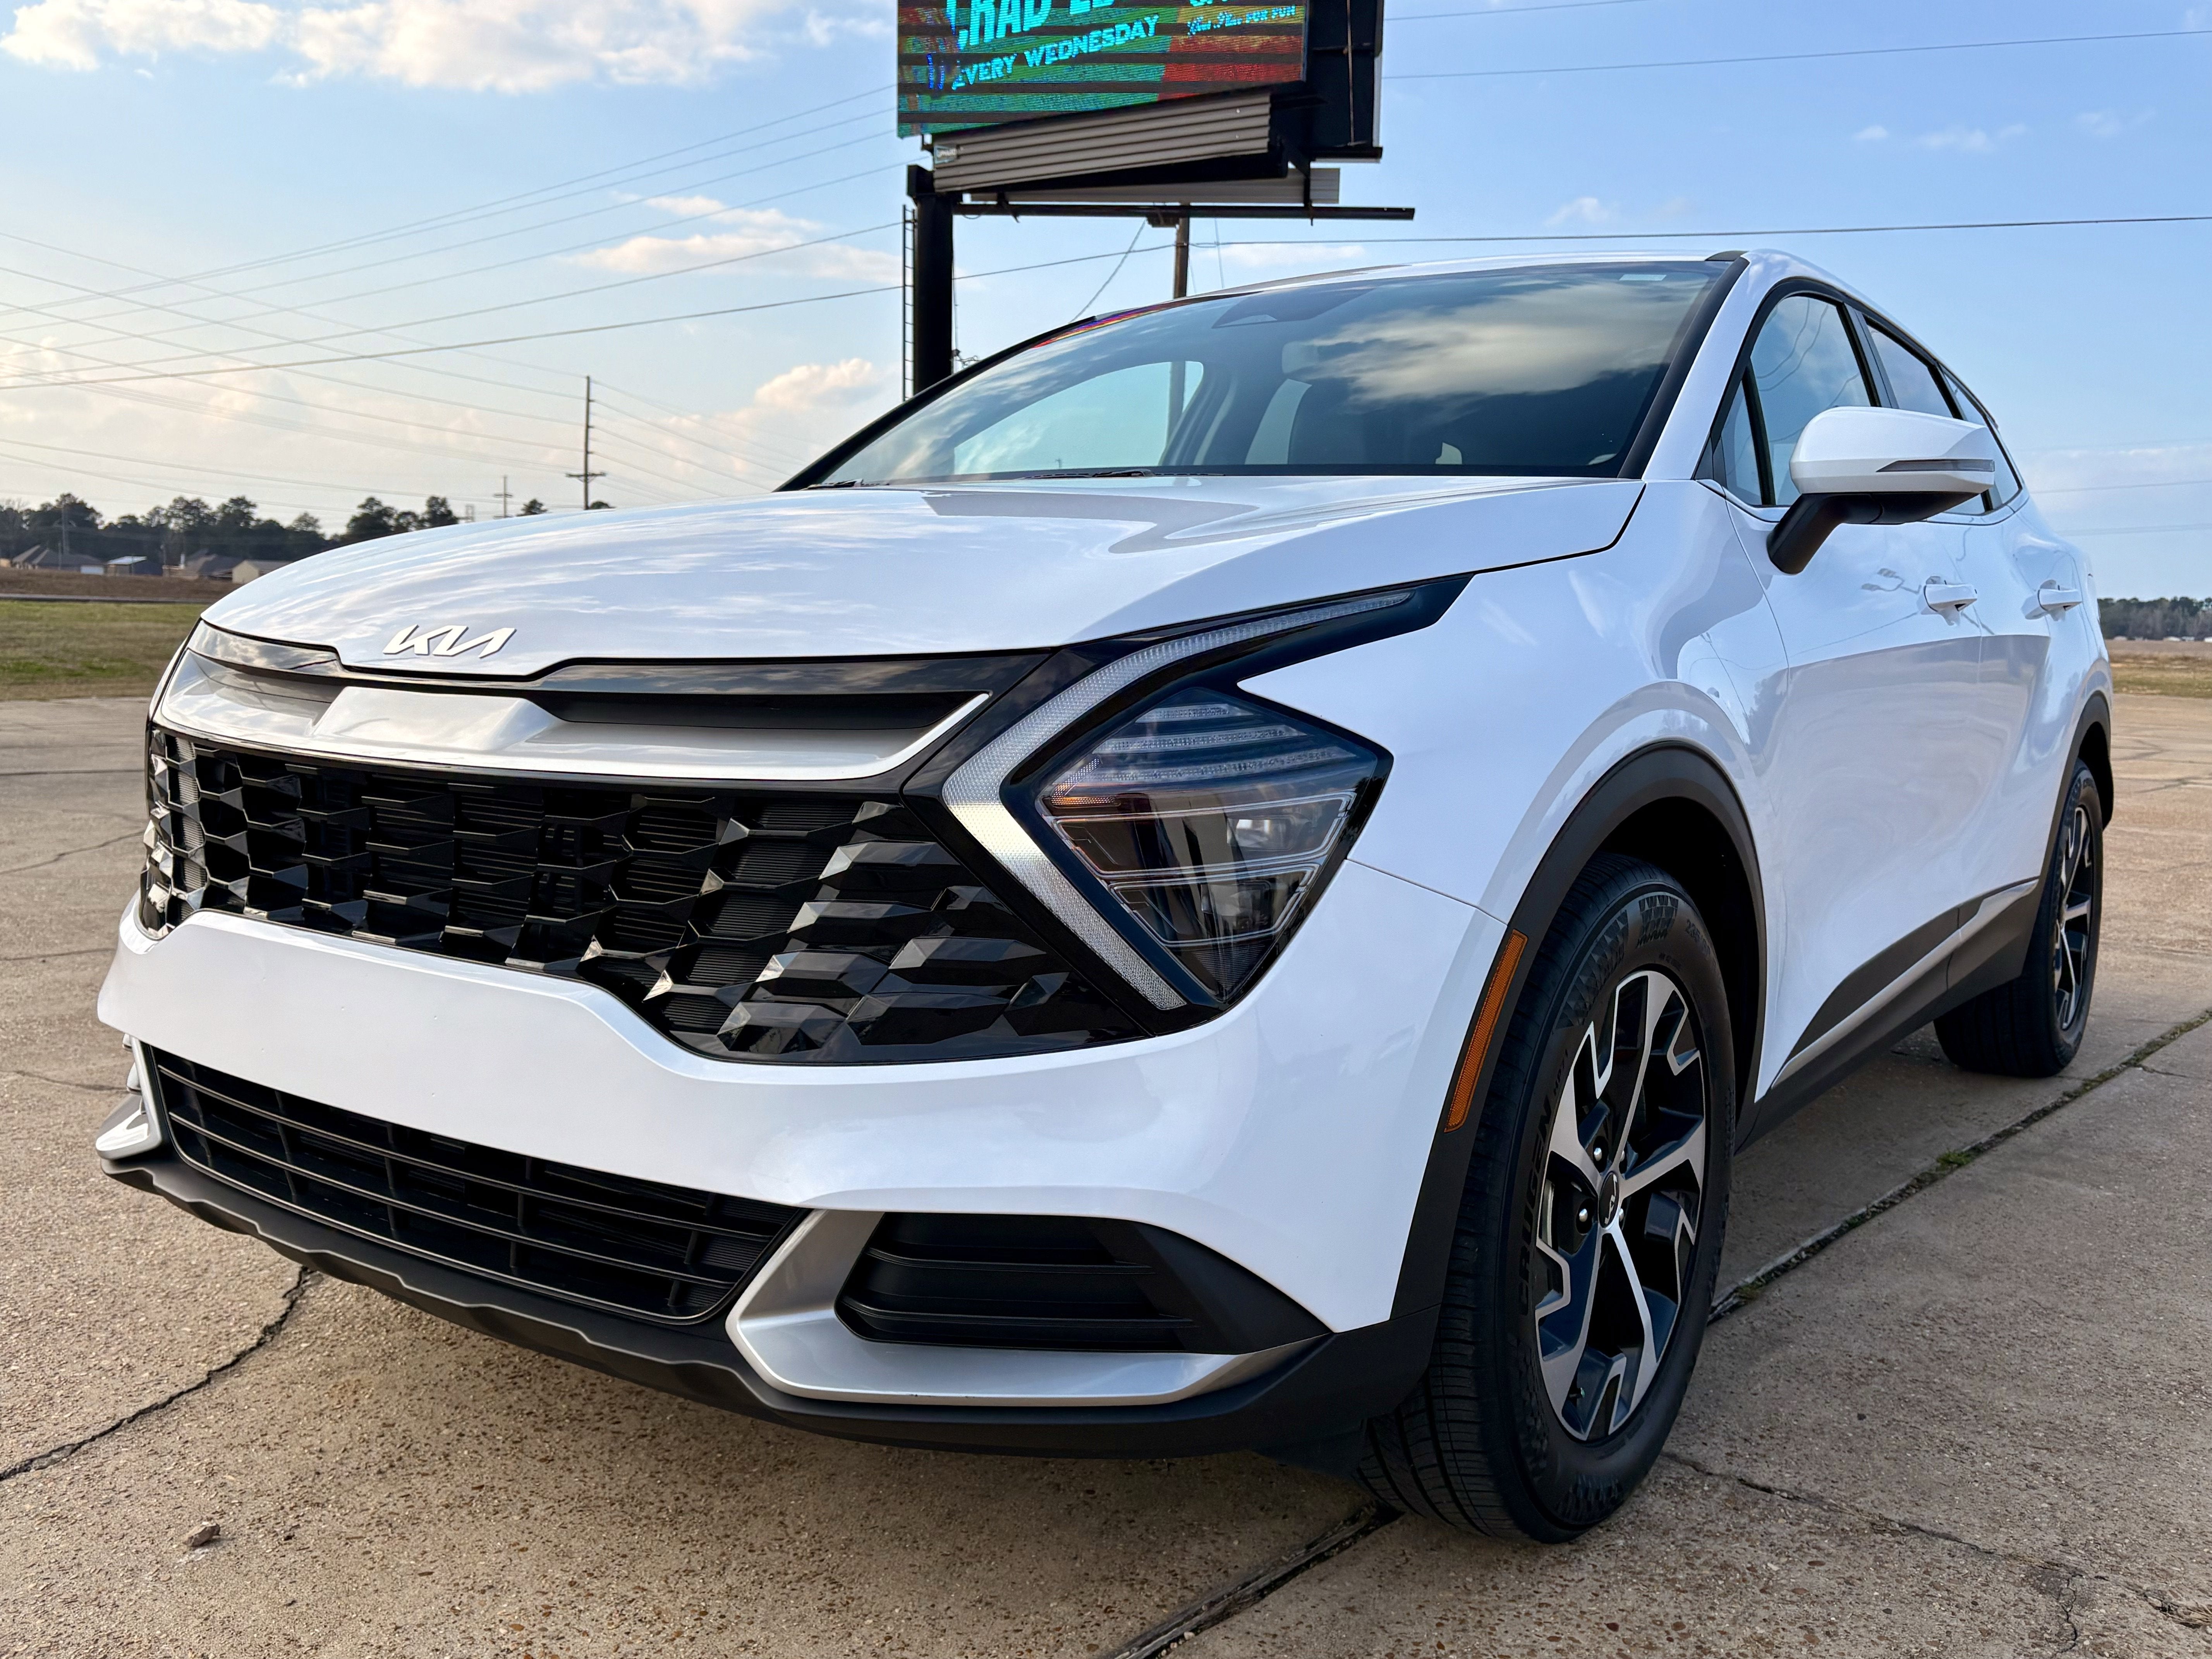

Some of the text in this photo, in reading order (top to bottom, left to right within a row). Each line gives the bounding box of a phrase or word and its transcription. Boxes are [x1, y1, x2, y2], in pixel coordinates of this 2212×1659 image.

[1024, 13, 1159, 67] WEDNESDAY
[382, 624, 517, 658] KIA
[1518, 1094, 1552, 1316] CRUGEN
